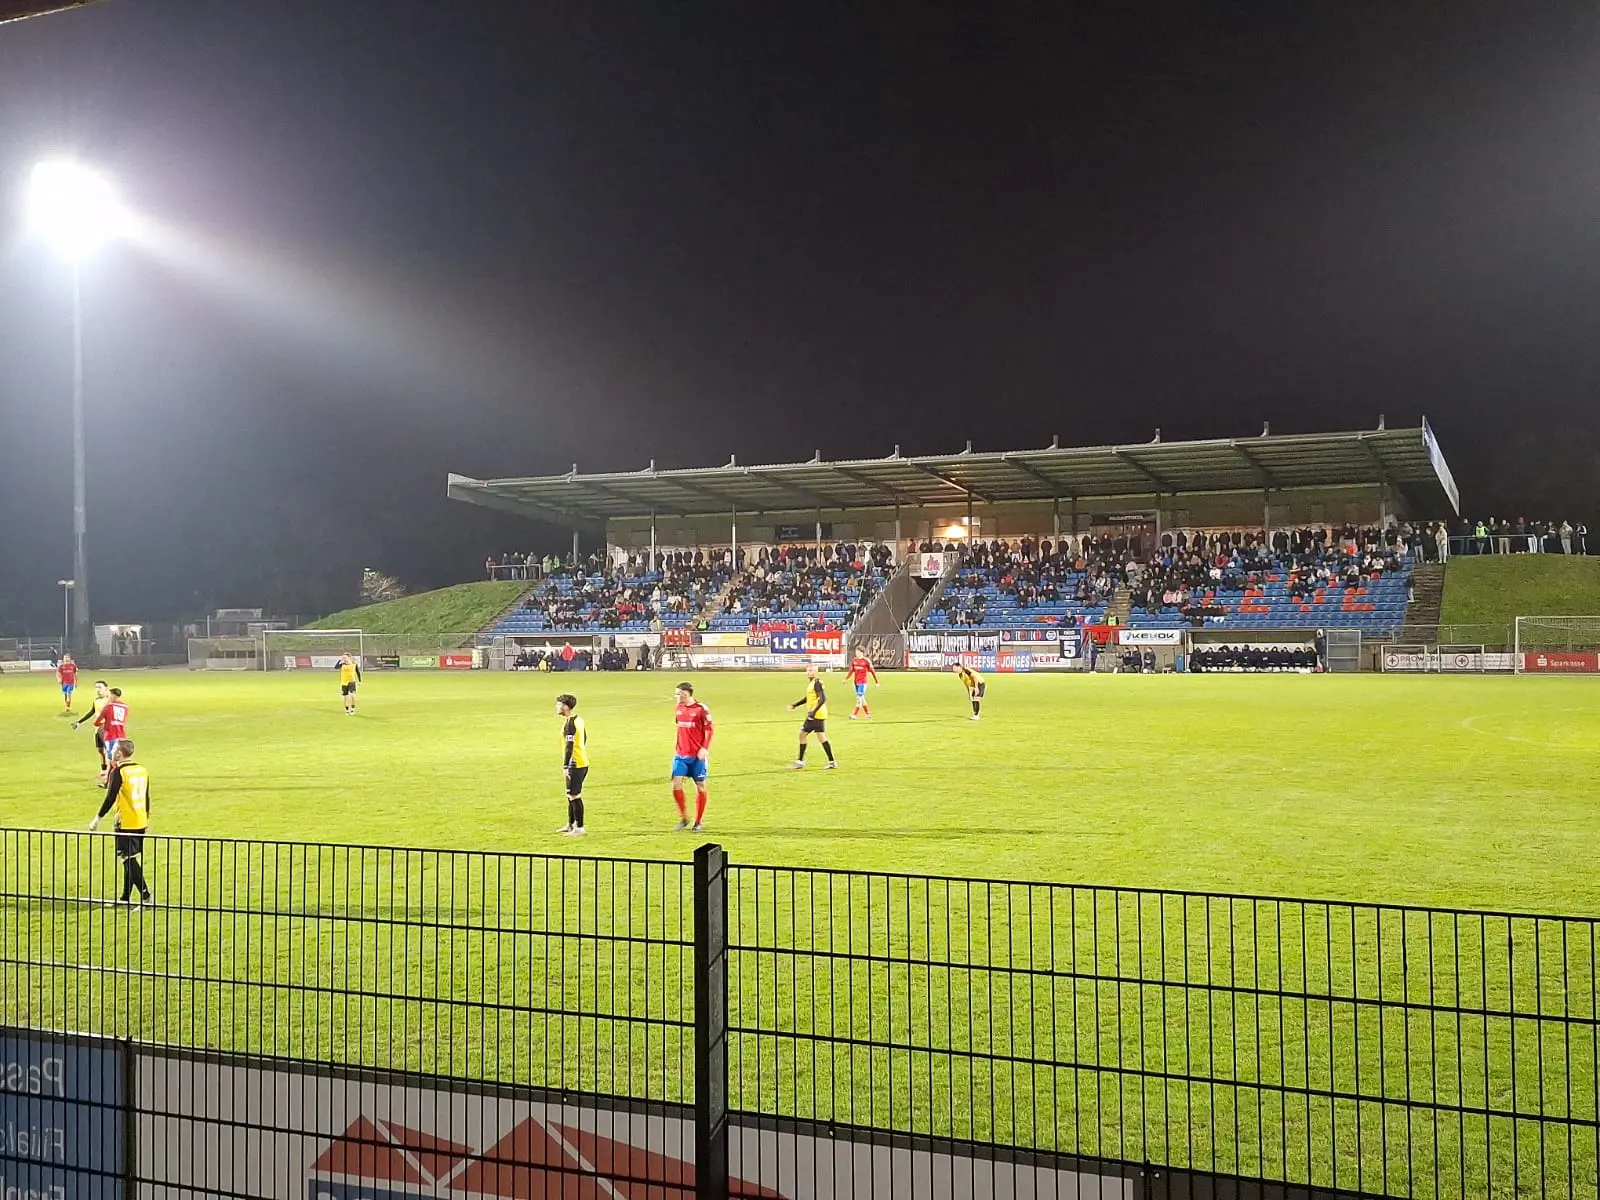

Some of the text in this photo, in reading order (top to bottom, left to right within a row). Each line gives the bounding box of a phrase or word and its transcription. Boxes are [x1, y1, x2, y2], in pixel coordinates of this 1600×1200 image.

[773, 638, 798, 650] 1.FC
[801, 638, 839, 650] KLEVE
[1063, 641, 1076, 658] 5
[963, 656, 996, 669] KLEEFSE
[1001, 655, 1030, 669] JONGES
[1032, 655, 1061, 663] WERTZ
[1550, 659, 1586, 667] Sparkasse
